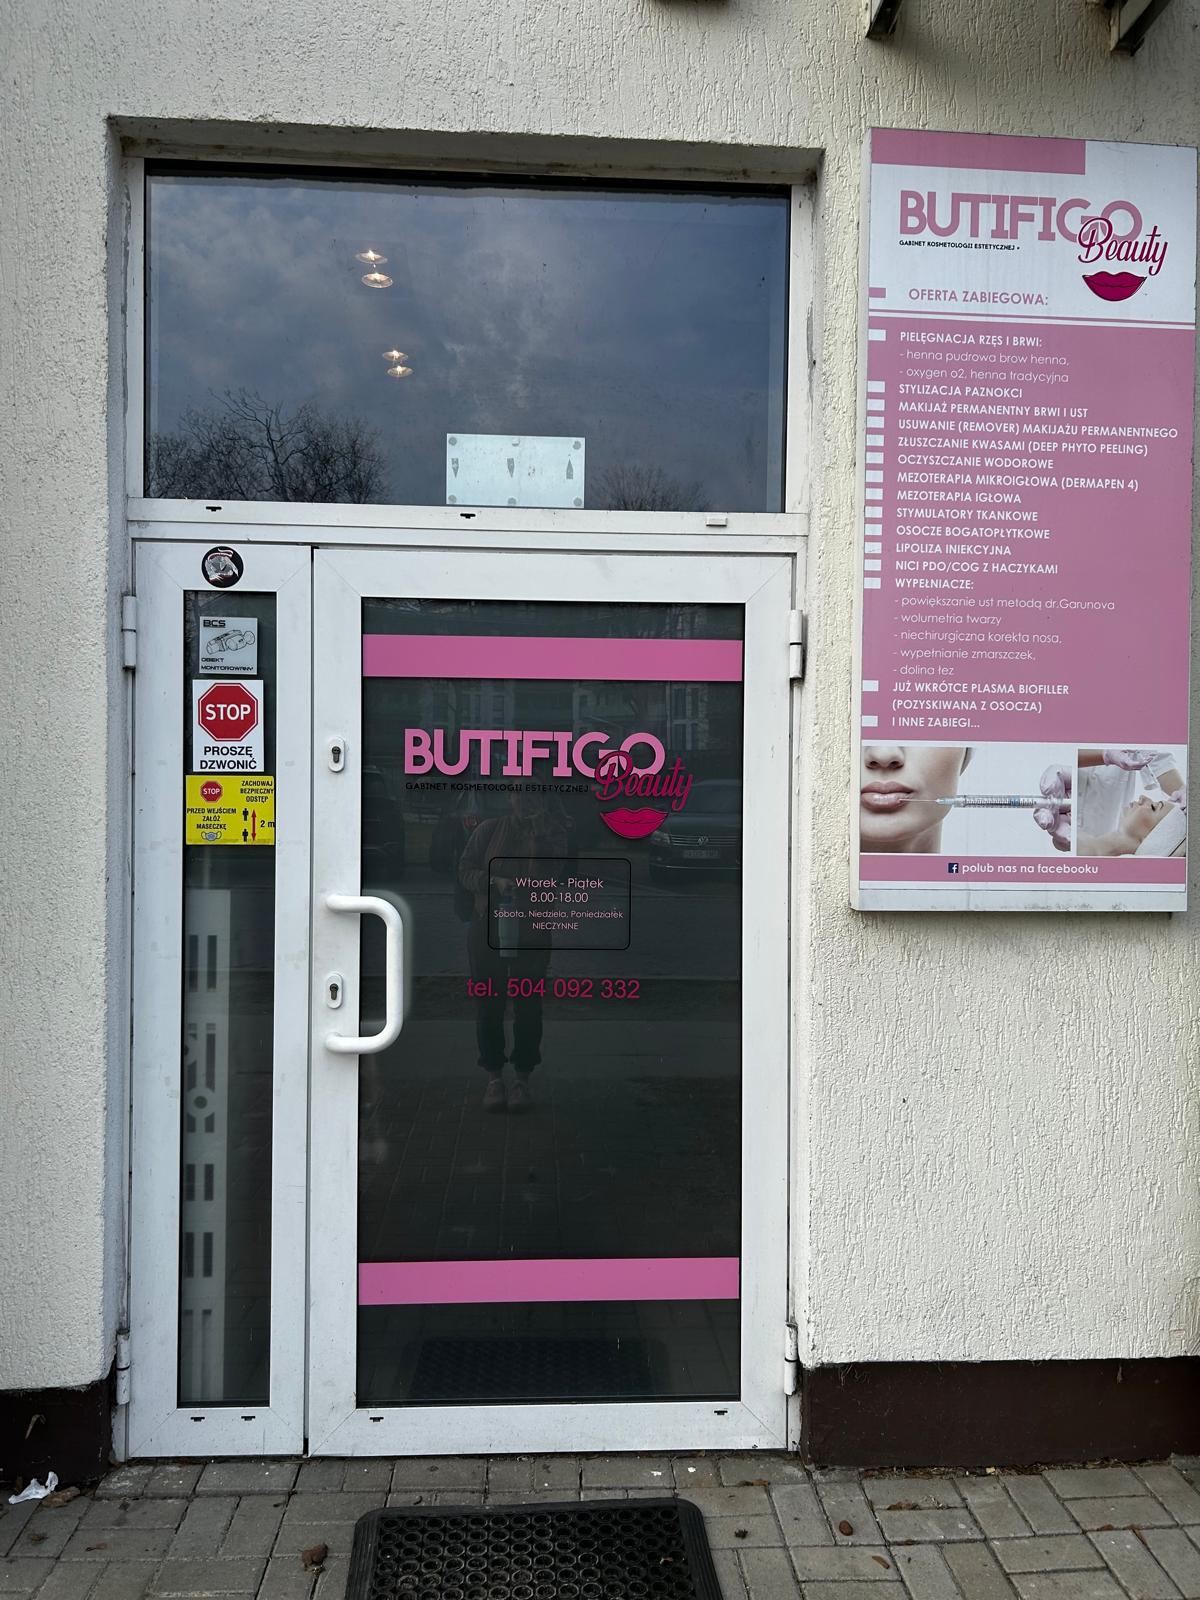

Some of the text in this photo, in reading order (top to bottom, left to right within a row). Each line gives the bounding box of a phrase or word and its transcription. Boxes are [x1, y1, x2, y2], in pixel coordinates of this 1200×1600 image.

[899, 190, 1143, 243] BUTIFIGO
[927, 241, 973, 249] KOSMETOLOGII
[974, 243, 1015, 251] ESTETYCZNEJ
[1077, 217, 1168, 276] Beauty
[909, 288, 1048, 306] OFERTA ZABIEGOWA:
[900, 331, 976, 345] PIELĘGNACJA
[979, 335, 1003, 347] RZĘS
[1012, 336, 1042, 347] BRWI:
[906, 349, 943, 361] henna
[945, 351, 997, 363] pudrowa
[999, 353, 1029, 364] brow
[1031, 355, 1070, 367] henna,
[906, 368, 948, 379] oxygen
[970, 369, 1007, 380] henna
[1010, 371, 1069, 384] tradycyjna
[899, 384, 1023, 398] STYLIZACJA PAZNOKCI
[898, 401, 947, 413] MAKIJAŻ
[950, 404, 1030, 416] PERMANENTNY
[1034, 407, 1060, 417] BRWI
[1070, 408, 1088, 418] UST
[898, 420, 1178, 438] USUWANIE (REMOVER) MAKIJAŻU PERMANENTNEGO
[898, 437, 1148, 457] ZŁUSZCZANIE KWASAMI (DEEP PHYTO PEELING)
[897, 455, 1054, 469] OCZYSZCZANIE WODOROWE
[897, 472, 1139, 492] MEZOTERAPIA MIKROIGŁOWA (DERMAPEN 4)
[896, 490, 1022, 504] MEZOTERAPIA IGŁOWA
[896, 507, 1038, 521] STYMULATORY TKANKOWE
[896, 525, 1050, 539] OSOCZE BOGATOPŁYTKOWE
[896, 543, 1012, 556] LIPOLIZA INIEKCYJNA
[895, 561, 1058, 574] NICI PDO/COG Z HACZYKAMI
[895, 578, 974, 590] WYPEŁNIACZE:
[901, 596, 976, 608] powiększanie
[979, 597, 994, 607] ust
[997, 597, 1042, 610] metodą
[1045, 598, 1115, 610] dr.Garunova
[203, 619, 226, 628] BCS
[901, 613, 963, 624] wolumetria
[966, 614, 1002, 626] twarzy
[901, 629, 985, 643] niechirurgiczna
[988, 631, 1029, 643] korekta
[900, 648, 968, 659] wypełnianie
[900, 665, 935, 676] dolina
[938, 665, 955, 676] łez
[893, 680, 1070, 694] JUŻ WKRÓTCE PLASMA BIOFILLER
[205, 703, 251, 721] STOP
[892, 699, 1042, 713] (POZYSKIWANA Z OSOCZA)
[899, 717, 925, 727] INNE
[927, 717, 980, 728] ZABIEGI...
[203, 746, 253, 758] PROSZĘ
[404, 728, 666, 777] BUTIFIGO
[200, 757, 257, 770] DZWONIĆ
[405, 782, 589, 793] GABINET KOSMETOLOGII ESTETYCZNEJ
[594, 750, 693, 811] Beauty
[207, 806, 237, 814] WEJŚCIEM
[260, 820, 265, 828] 2
[962, 863, 994, 875] polub
[997, 865, 1017, 874] nas
[1020, 865, 1034, 874] na
[1037, 863, 1098, 874] facebooku
[515, 877, 557, 888] Wtorek
[567, 877, 604, 889] Piątek
[530, 892, 588, 903] 8.00-18.00
[570, 910, 623, 919] Poniedziałek
[532, 922, 579, 930] NIECZYNNE
[466, 977, 640, 999] tel. 504 092 332
